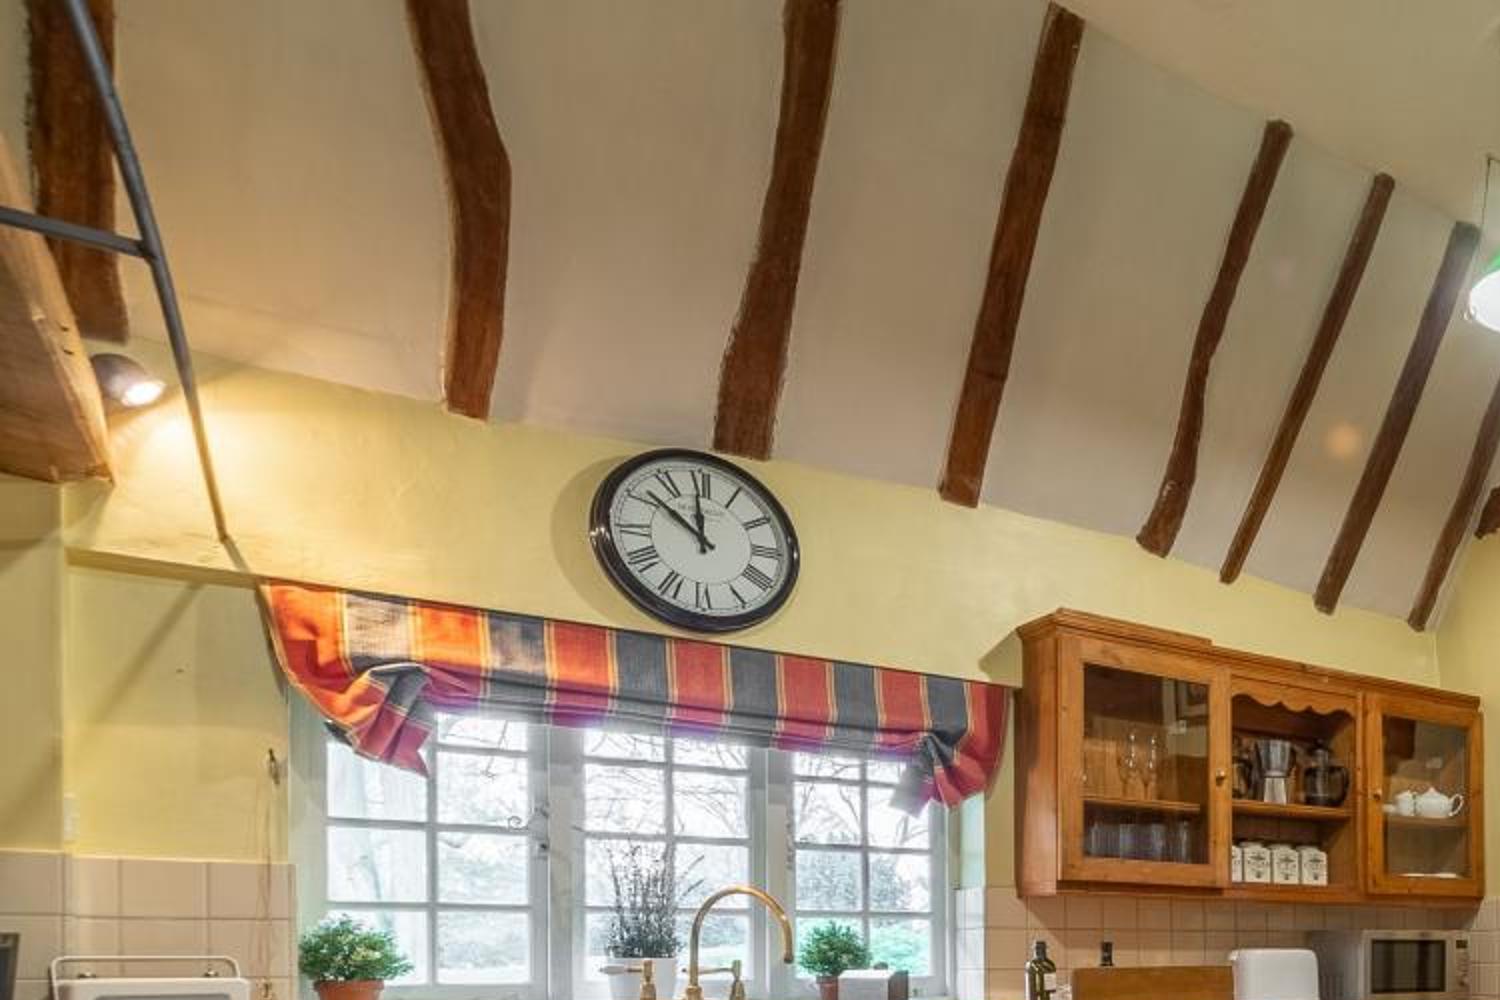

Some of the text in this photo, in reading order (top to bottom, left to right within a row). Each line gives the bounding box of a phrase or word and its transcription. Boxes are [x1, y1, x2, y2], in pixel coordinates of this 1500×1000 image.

[725, 486, 743, 509] I
[743, 517, 770, 531] II
[750, 545, 781, 560] III
